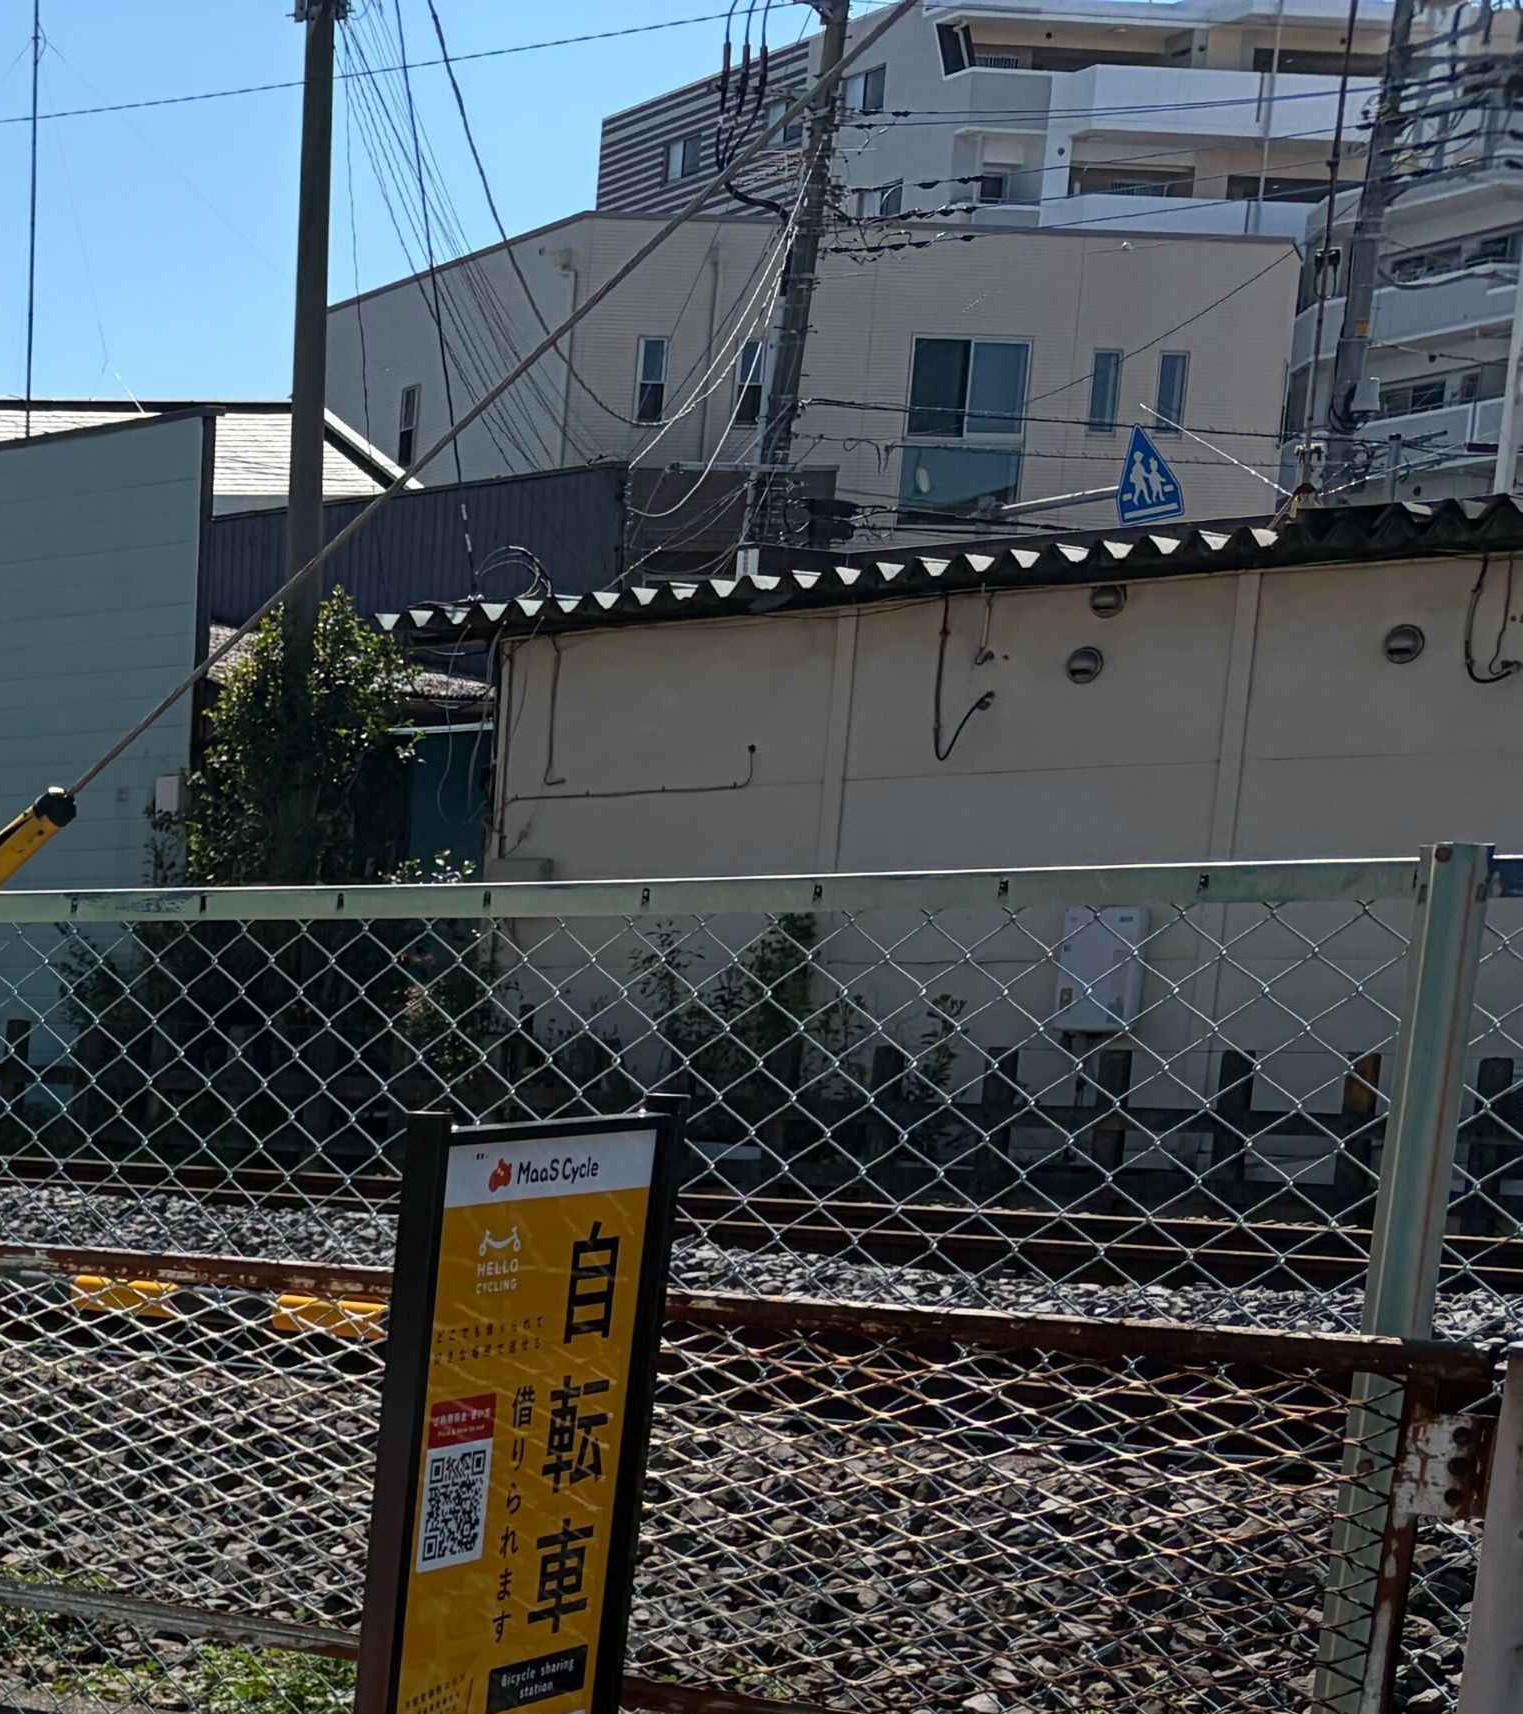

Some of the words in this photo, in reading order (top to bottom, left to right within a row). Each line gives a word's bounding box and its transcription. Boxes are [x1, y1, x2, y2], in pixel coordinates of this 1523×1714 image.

[517, 1159, 560, 1184] MaaS
[562, 1156, 599, 1184] Cycle
[477, 1258, 519, 1276] HELLO
[475, 1278, 518, 1294] CYCLING
[527, 1221, 620, 1634] 自転車
[493, 1386, 536, 1643] 借りられます
[501, 1665, 536, 1688] Bicycle
[540, 1657, 575, 1677] sharing
[519, 1680, 553, 1699] station
